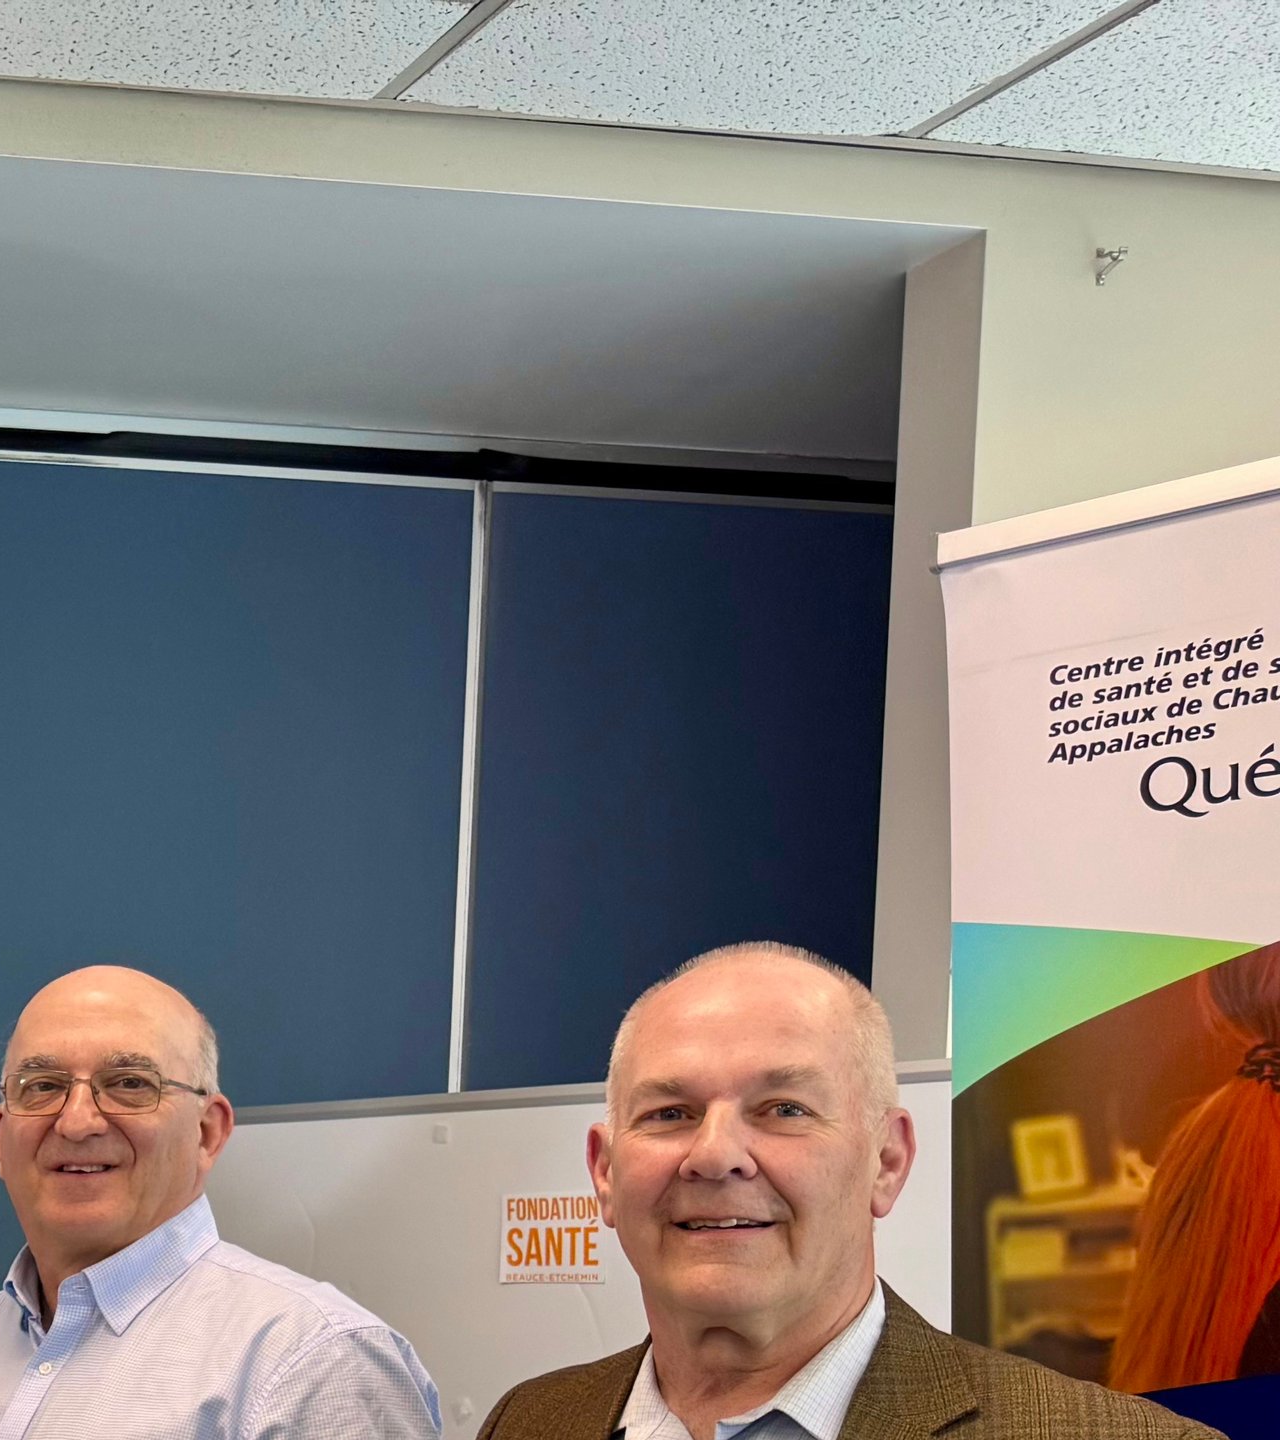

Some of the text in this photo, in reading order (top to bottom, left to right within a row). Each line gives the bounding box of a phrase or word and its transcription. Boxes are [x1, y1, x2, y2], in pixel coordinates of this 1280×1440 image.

[1049, 656, 1144, 685] Centre
[1154, 628, 1264, 668] intégré
[1049, 692, 1083, 711] de
[1092, 672, 1172, 704] santé
[1182, 667, 1213, 689] et
[1222, 660, 1259, 683] de
[1048, 705, 1158, 737] sociaux
[1166, 697, 1202, 719] de
[1048, 721, 1216, 764] Appalaches
[507, 1196, 599, 1221] FONDATION
[507, 1220, 599, 1267] SANTÉ
